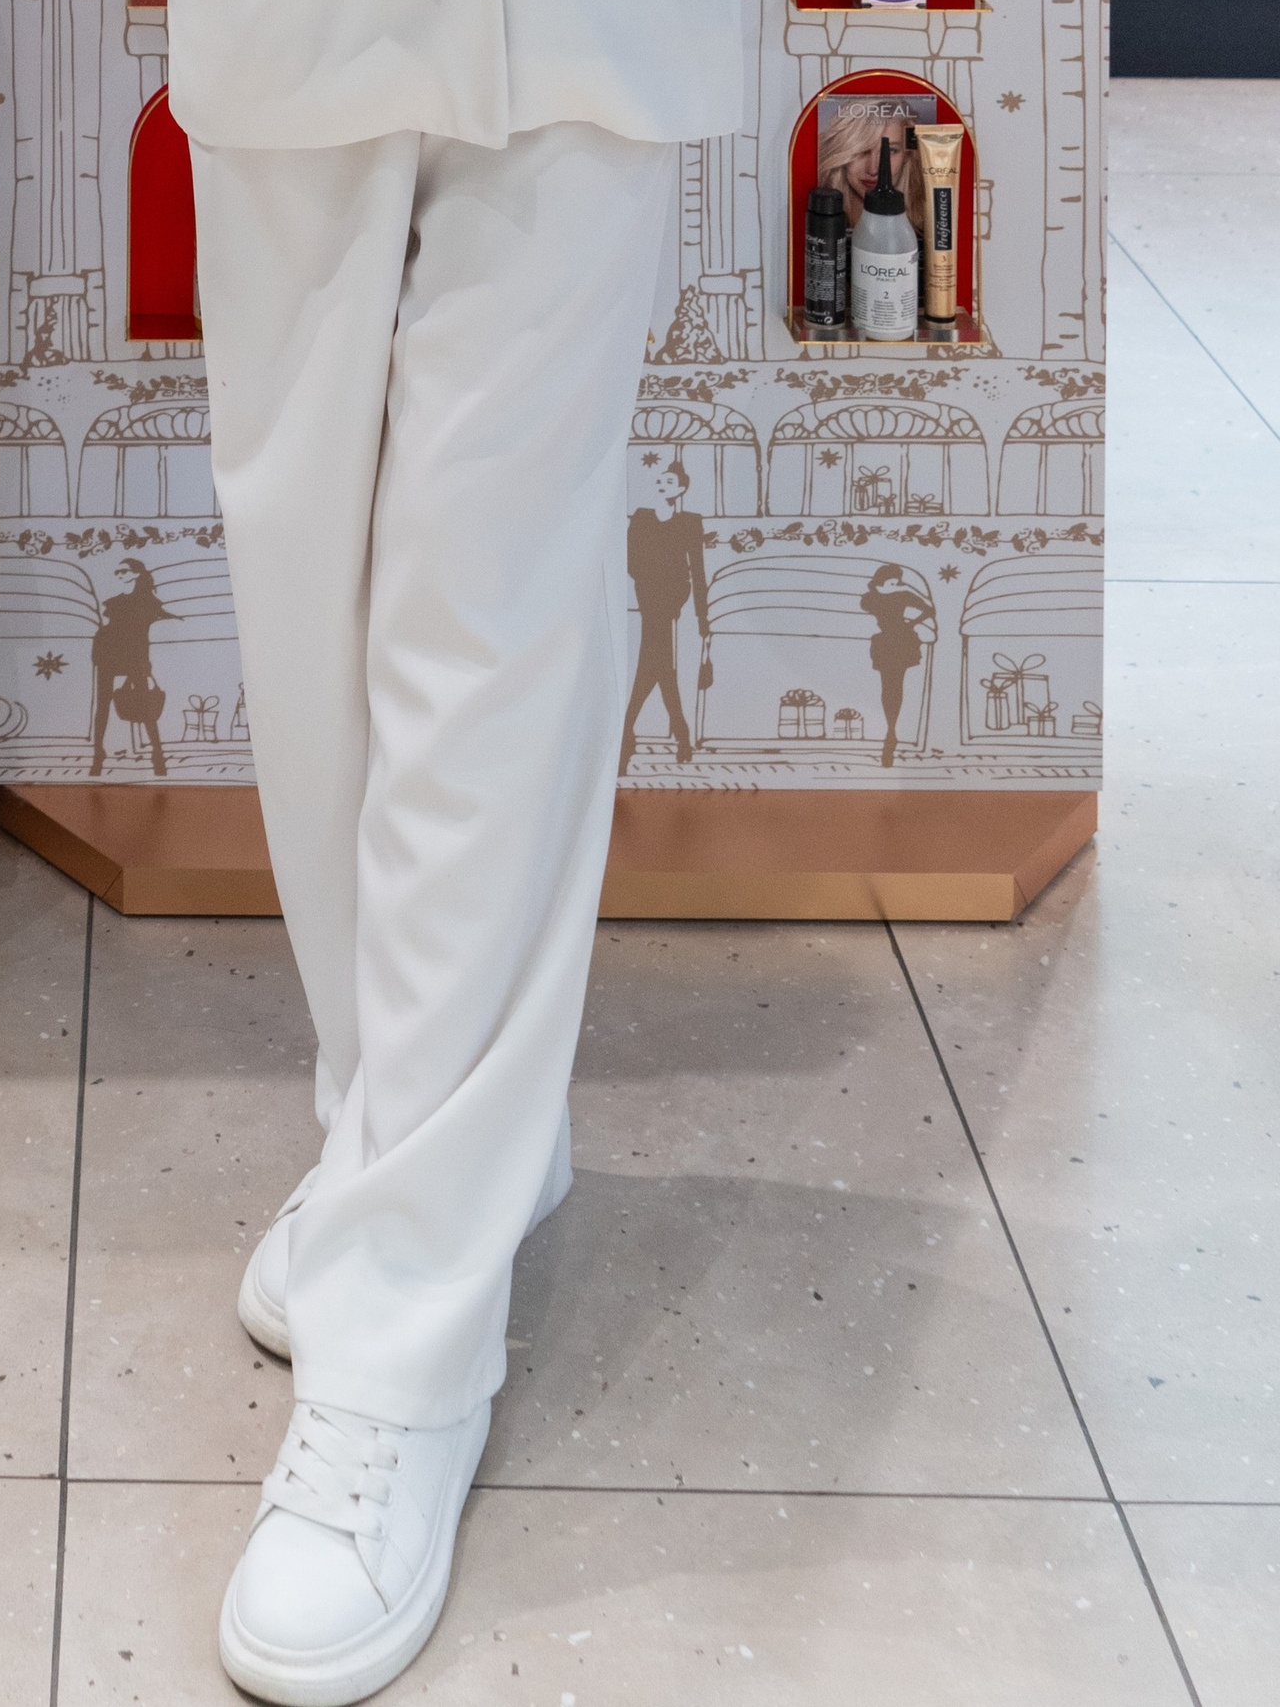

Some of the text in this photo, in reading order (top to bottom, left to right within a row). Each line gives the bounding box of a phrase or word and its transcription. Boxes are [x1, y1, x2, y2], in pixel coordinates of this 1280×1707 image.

[837, 103, 917, 119] L'ORÉAL
[937, 190, 949, 249] Préférence
[860, 264, 910, 278] L'ORÉAL
[883, 291, 890, 300] 2
